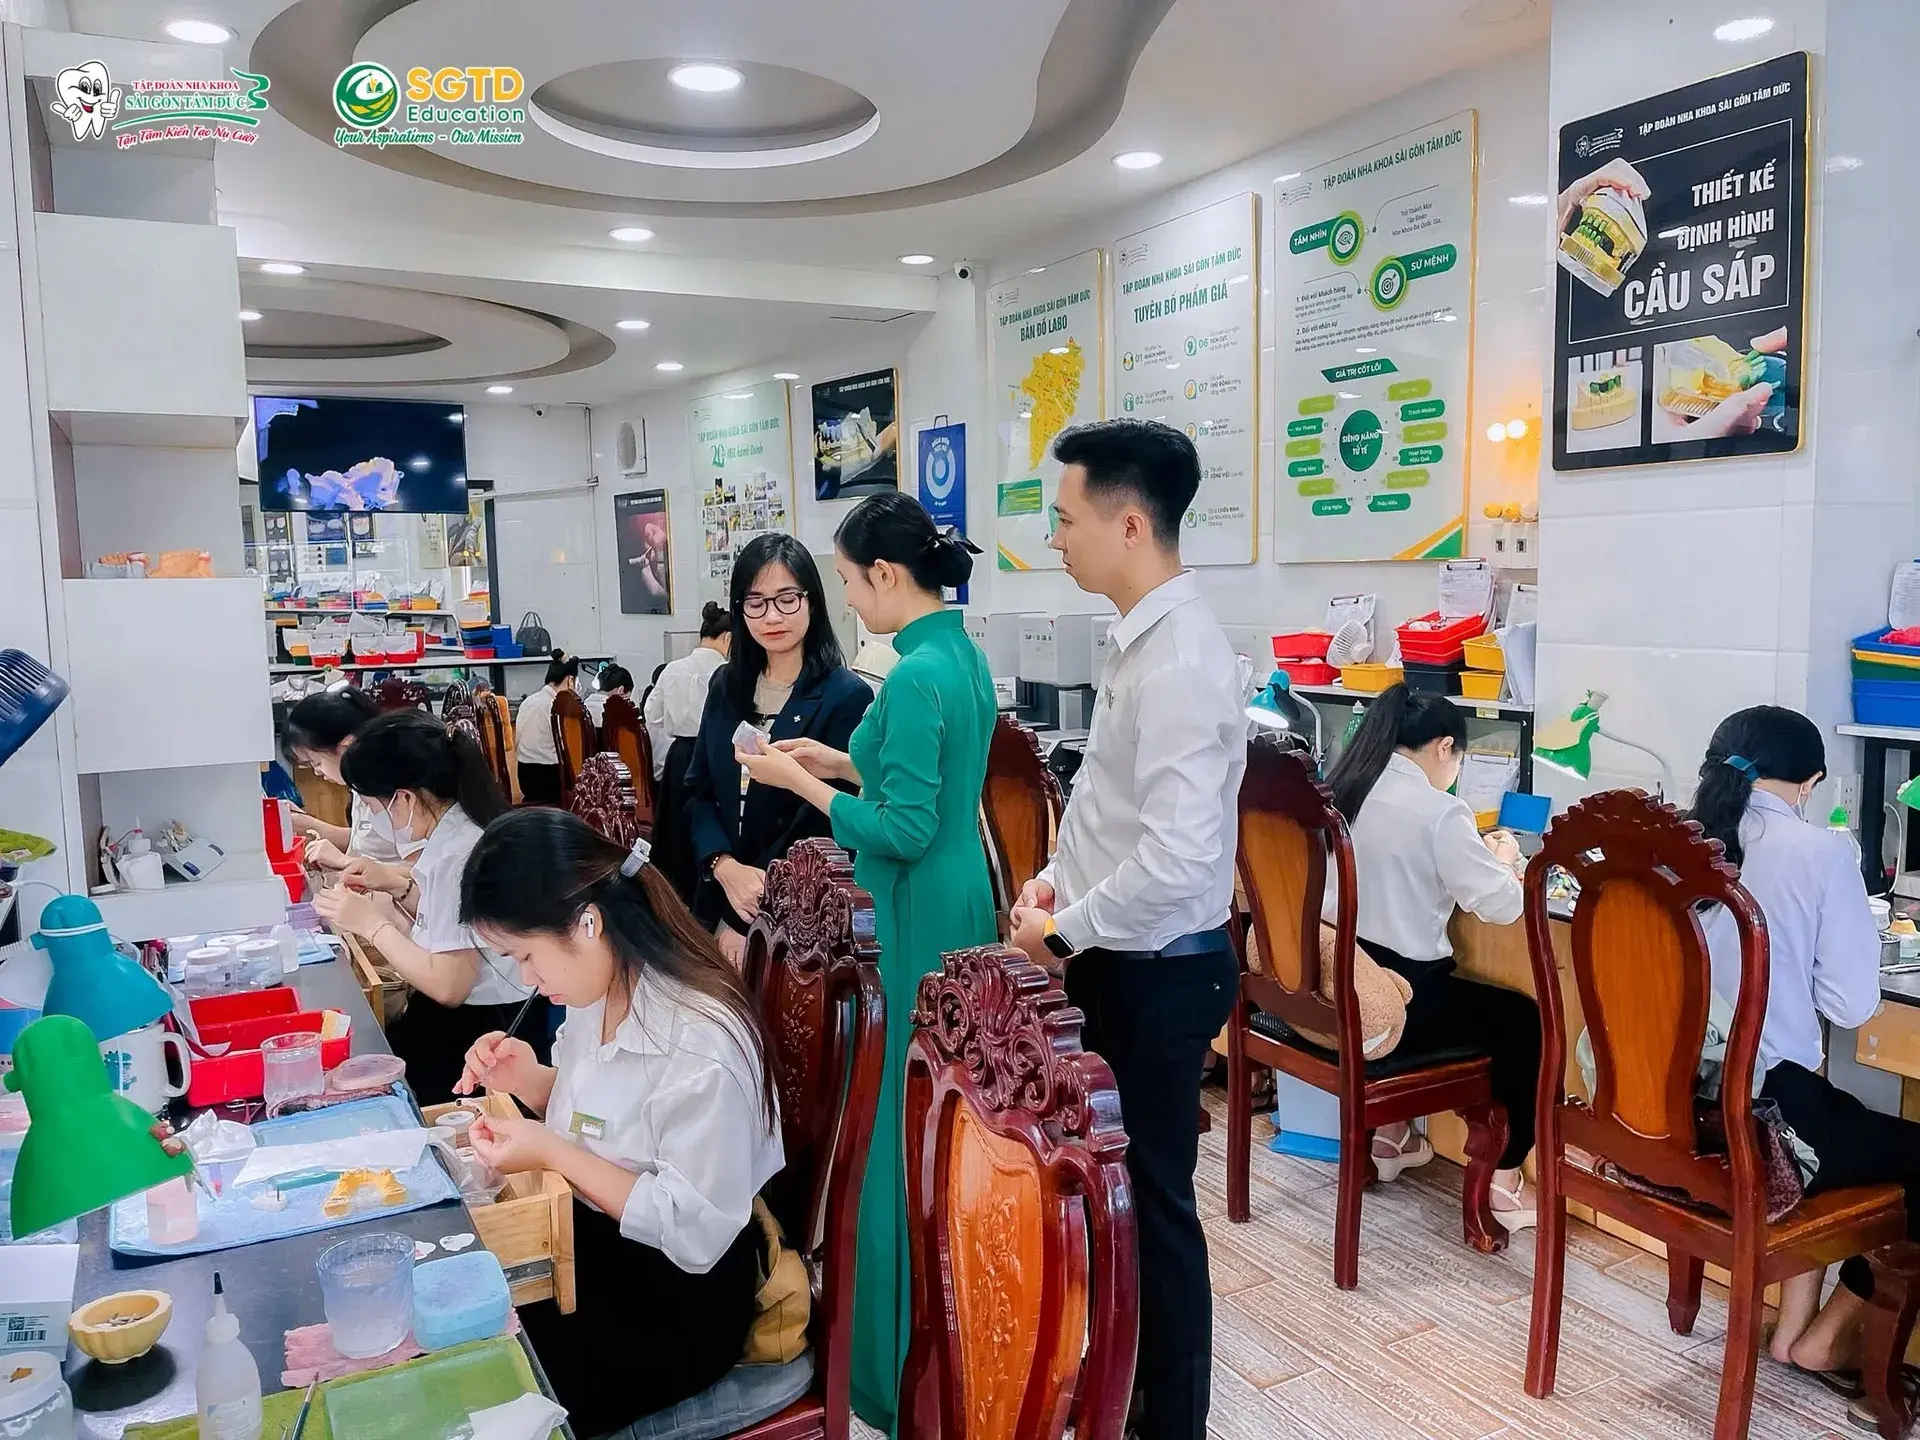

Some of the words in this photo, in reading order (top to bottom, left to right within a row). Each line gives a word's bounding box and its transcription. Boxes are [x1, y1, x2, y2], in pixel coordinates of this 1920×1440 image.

[1638, 123, 1654, 136] TẬP
[1654, 115, 1676, 131] ĐOÀN
[1677, 111, 1694, 124] NHA
[1695, 104, 1717, 119] KHOA
[1718, 98, 1732, 112] SÀI
[1734, 93, 1751, 108] GÒN
[1752, 87, 1771, 103] TÂM
[1772, 80, 1791, 97] ĐỨC
[1323, 175, 1337, 190] TẬP
[1337, 168, 1357, 185] ĐOÀN
[1357, 164, 1373, 178] NHA
[1373, 155, 1394, 172] KHOA
[1395, 148, 1408, 164] SÀI
[1409, 143, 1425, 159] GÒN
[1426, 137, 1444, 153] TÂM
[1445, 129, 1462, 147] ĐỨC
[1692, 169, 1744, 207] THIẾT
[1749, 158, 1777, 194] KẾ
[1309, 229, 1327, 242] NHÌN
[1677, 220, 1722, 252] ĐỊNH
[1727, 209, 1775, 240] HÌNH
[1424, 253, 1449, 268] MỆNH
[1122, 281, 1133, 296] TẬP
[1134, 278, 1150, 292] ĐOÀN
[1151, 272, 1164, 286] NHA
[1165, 267, 1182, 282] KHOA
[1624, 262, 1691, 319] CẦU
[1701, 250, 1775, 304] SÁP
[1134, 300, 1162, 324] TUYÊN
[1164, 290, 1178, 316] BỐ
[1179, 283, 1208, 312] PHẨM
[1210, 278, 1228, 302] GIÁ
[1020, 322, 1035, 342] BẢN
[1036, 316, 1047, 337] ĐỒ
[1048, 315, 1068, 333] LABO
[1198, 338, 1209, 349] 06
[1135, 353, 1143, 363] 01
[1335, 368, 1346, 379] GIÁ
[1347, 367, 1357, 377] TRỊ
[1357, 364, 1370, 376] CỐT
[1198, 382, 1208, 393] 07
[1135, 395, 1144, 406] 02
[1342, 433, 1360, 443] SIÊNG
[1198, 513, 1207, 523] 10
